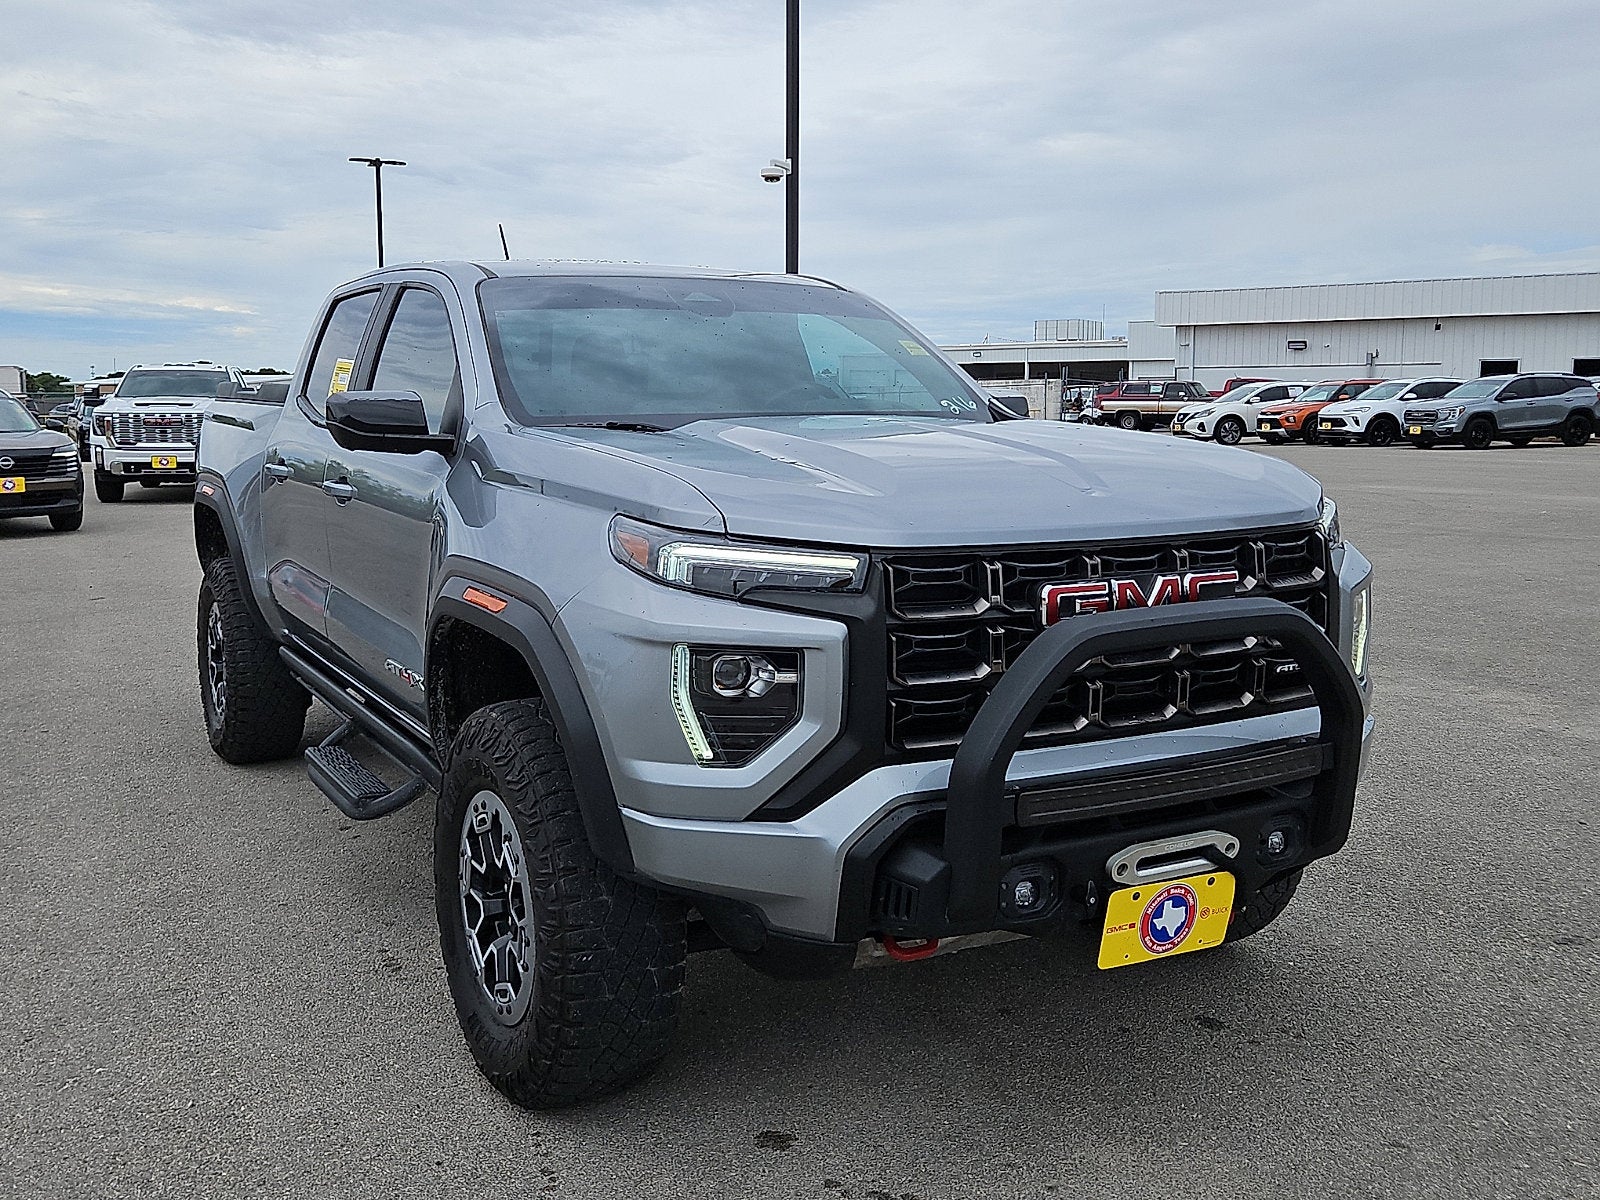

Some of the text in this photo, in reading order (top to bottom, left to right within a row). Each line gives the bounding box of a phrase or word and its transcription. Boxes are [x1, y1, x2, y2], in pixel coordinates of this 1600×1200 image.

[384, 659, 425, 691] AT4X
[1146, 892, 1168, 915] Mitchell
[1211, 907, 1229, 915] BUICK
[1106, 924, 1129, 934] GMC
[1144, 936, 1153, 948] San
[1174, 928, 1189, 945] Texas
